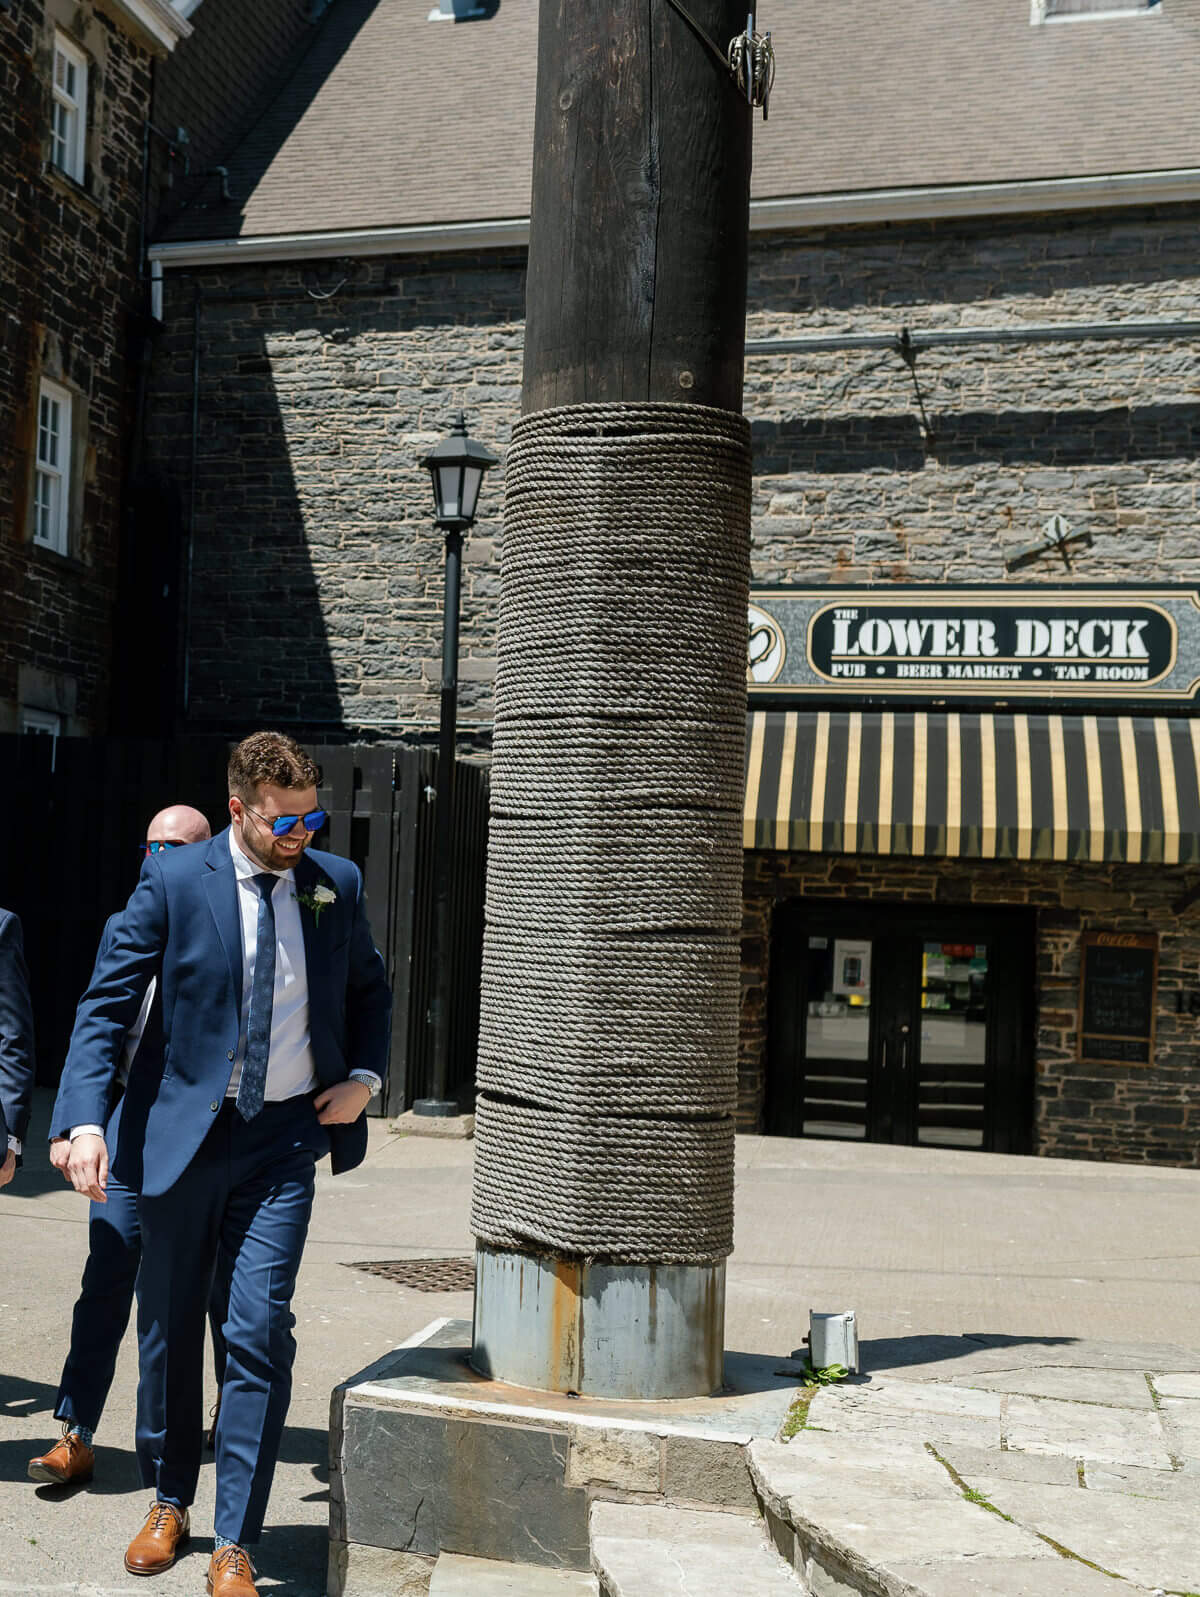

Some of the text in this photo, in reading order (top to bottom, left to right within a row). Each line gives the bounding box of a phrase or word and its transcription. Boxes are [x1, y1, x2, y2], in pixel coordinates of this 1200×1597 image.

[833, 609, 859, 620] THE
[832, 618, 1150, 658] LOWER DECK
[831, 663, 1150, 681] PUB BEER MARKET TAP ROOM
